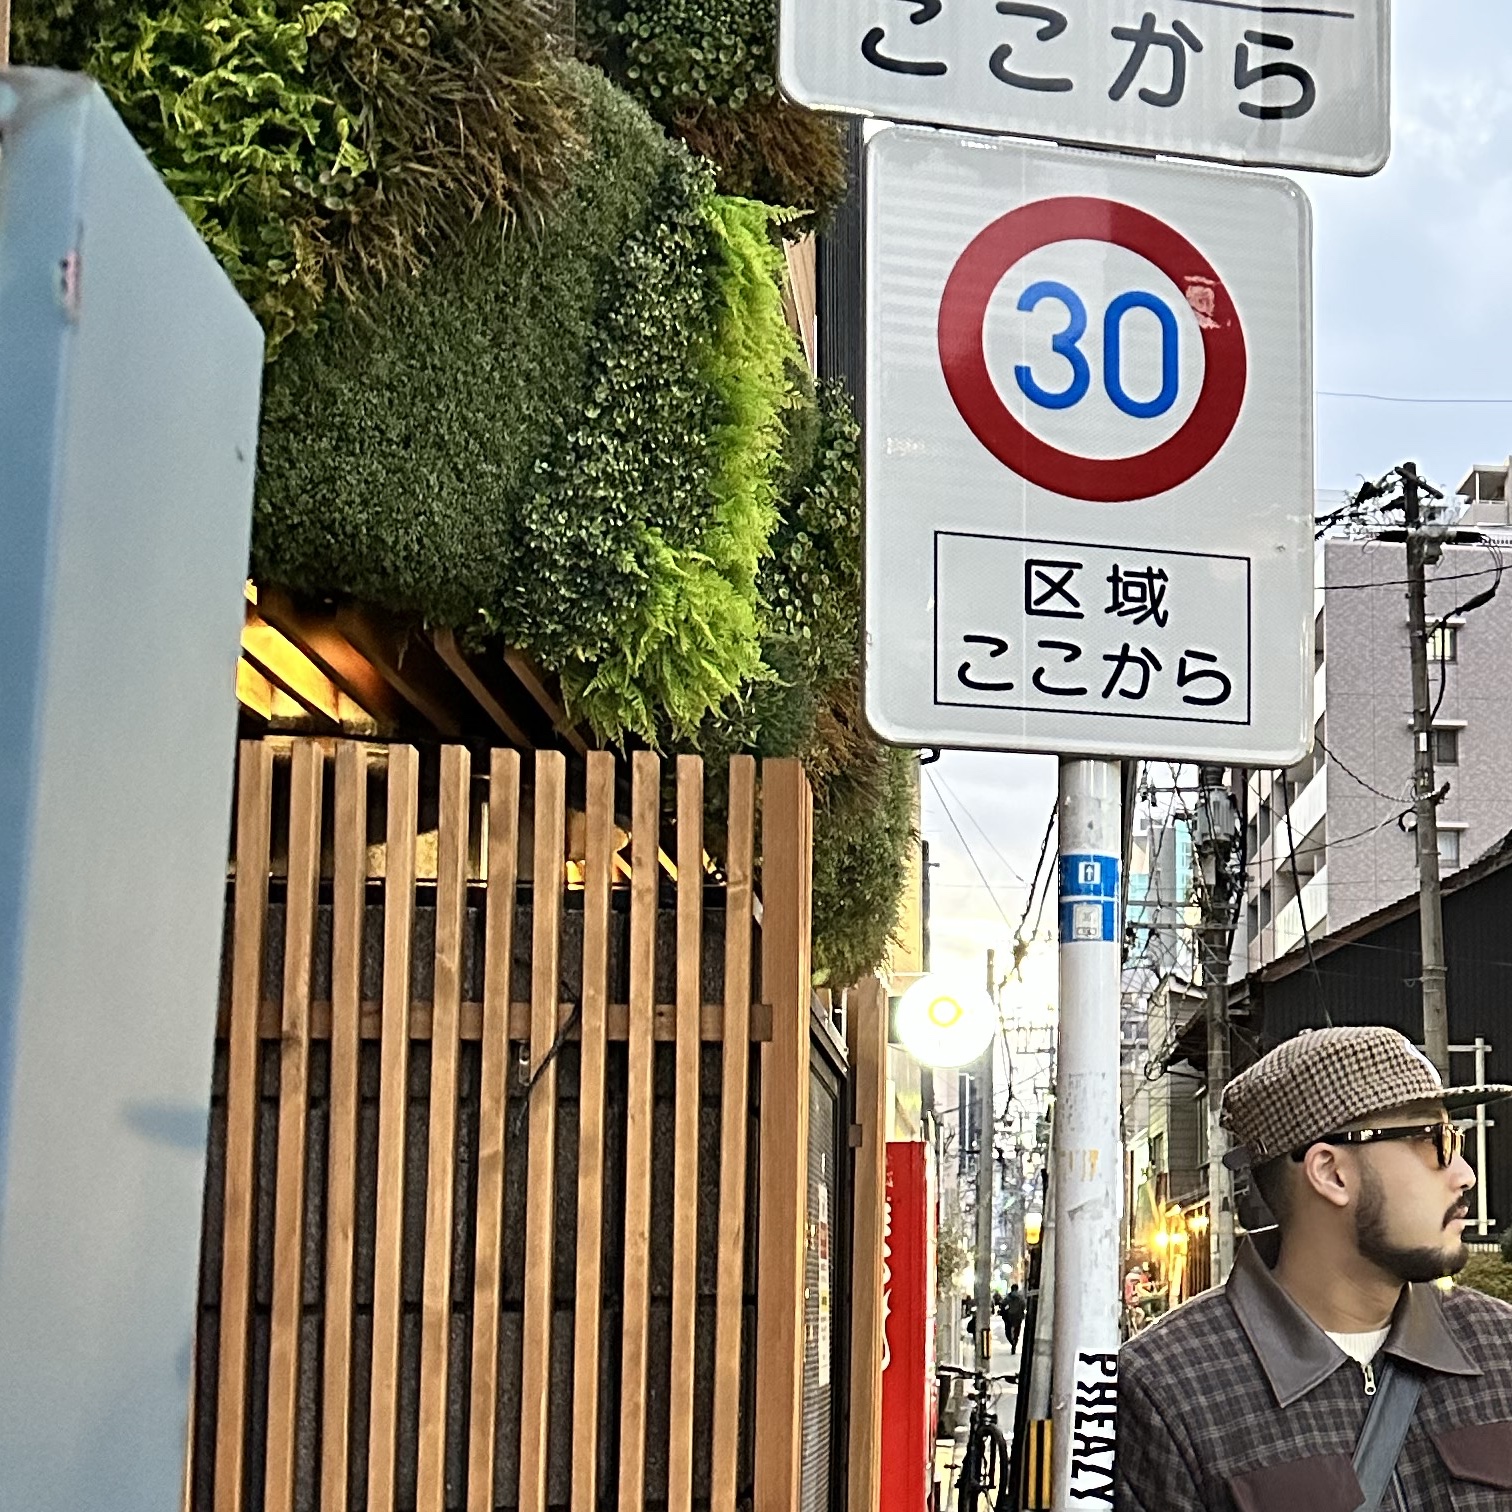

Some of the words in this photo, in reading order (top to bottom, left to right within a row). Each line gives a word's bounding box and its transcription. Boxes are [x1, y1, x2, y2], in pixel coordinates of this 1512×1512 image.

[860, 0, 1317, 120] ここから
[1013, 279, 1180, 419] 30
[1023, 558, 1169, 628] 区域
[956, 633, 1232, 706] ここから
